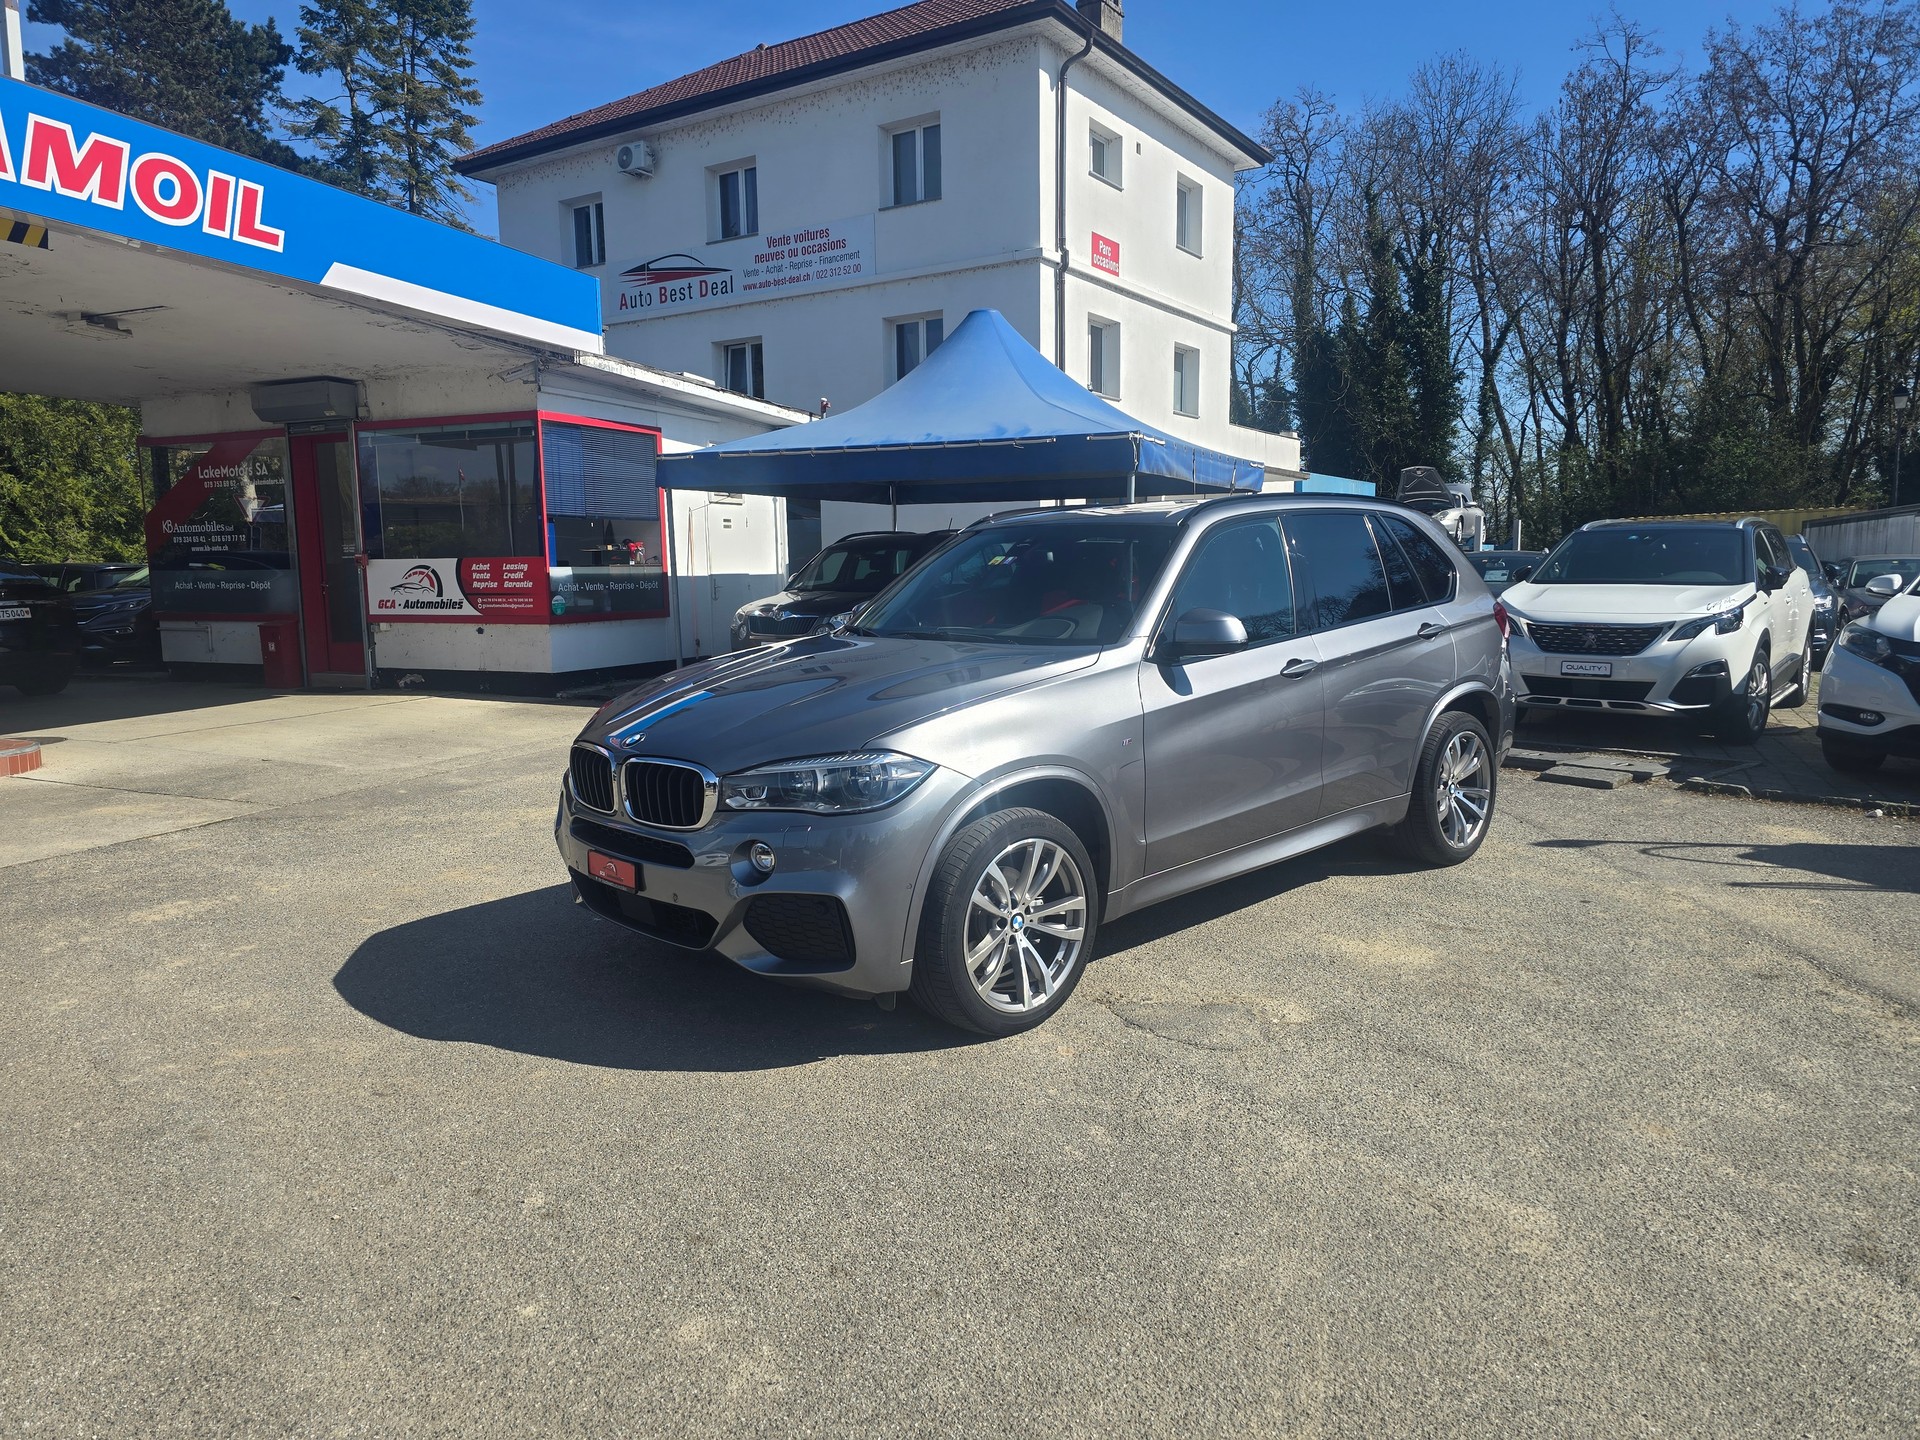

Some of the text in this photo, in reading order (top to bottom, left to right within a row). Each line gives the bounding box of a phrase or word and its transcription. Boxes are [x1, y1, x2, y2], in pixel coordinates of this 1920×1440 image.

[766, 228, 830, 249] Vente voitures
[754, 238, 847, 264] neuves ou occasions
[1099, 240, 1112, 257] Parc
[743, 268, 760, 278] Vente
[765, 264, 784, 274] Achat
[789, 259, 813, 271] Reprise
[819, 250, 860, 265] Financement
[742, 273, 811, 291] www.auto-best-deal.ch
[815, 269, 829, 279] 022
[829, 267, 842, 277] 312
[843, 265, 851, 275] 52
[852, 263, 862, 273] 00
[619, 275, 733, 310] Auto Best Deal
[198, 462, 268, 479] LakeMotors SA
[471, 563, 490, 571] Achat
[502, 562, 528, 571] Leasing
[221, 581, 245, 590] Reprise
[251, 581, 271, 590] Dépôt
[472, 581, 498, 589] Reprise
[503, 580, 533, 588] Garantie
[558, 583, 580, 592] Achat
[584, 582, 605, 591] Vente
[609, 581, 635, 592] Reprise
[640, 580, 659, 590] Dépôt
[377, 599, 396, 610] GCA
[403, 599, 463, 610] Automobiles
